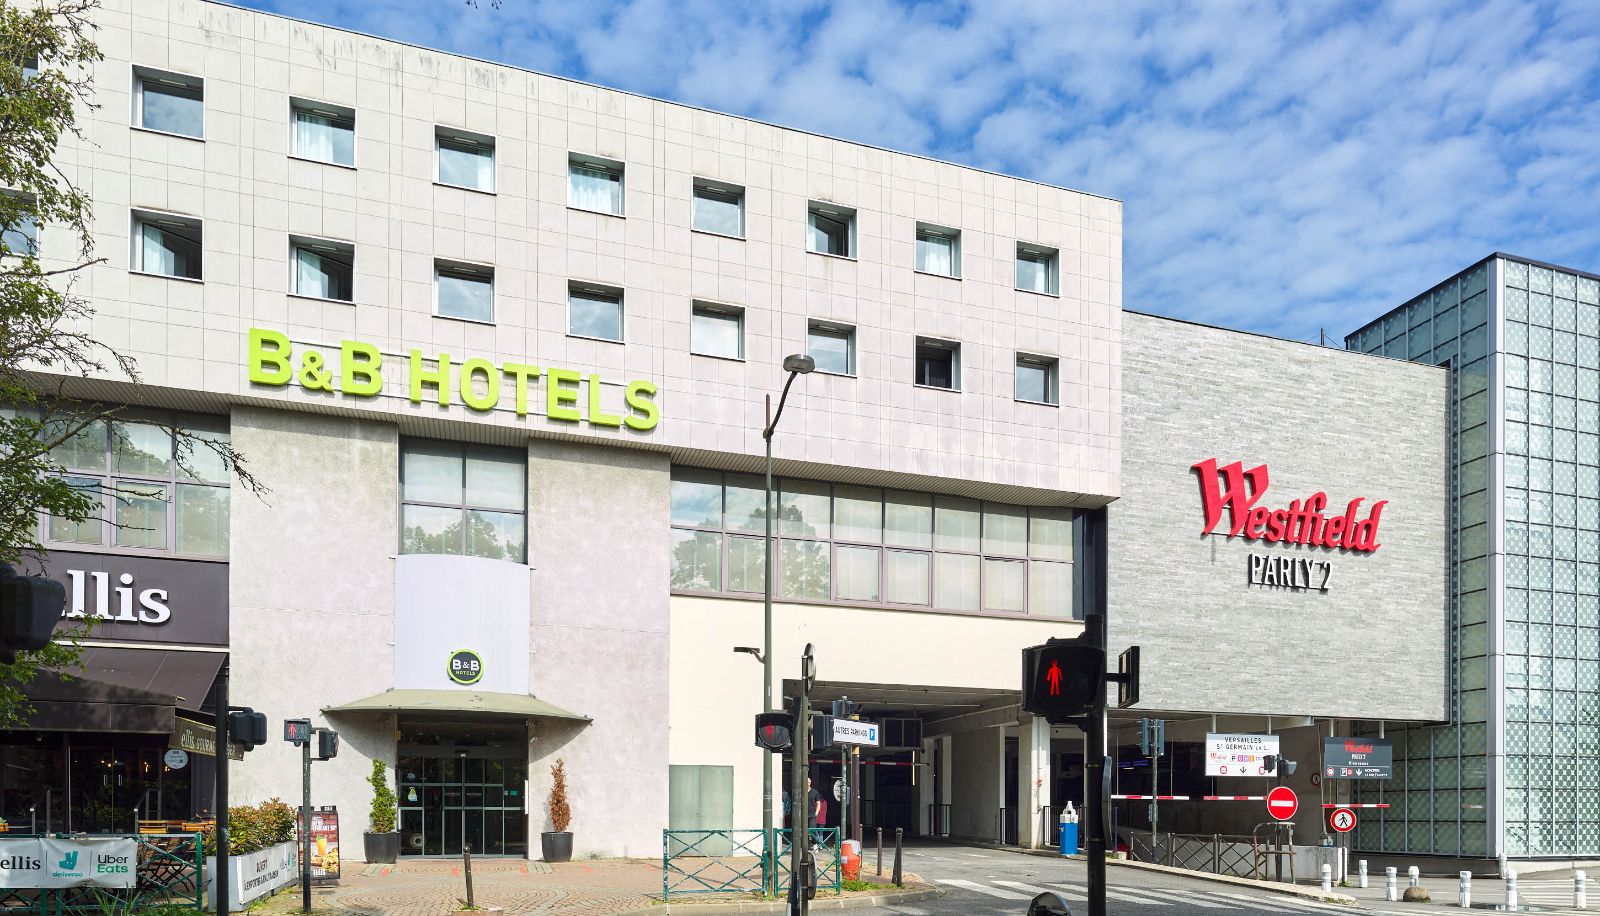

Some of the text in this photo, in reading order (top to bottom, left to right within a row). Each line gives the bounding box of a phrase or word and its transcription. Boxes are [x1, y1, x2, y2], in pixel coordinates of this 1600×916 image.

[248, 326, 661, 432] B&B HOTELS
[1190, 457, 1389, 552] Westfield
[1250, 553, 1334, 590] PARLY 2
[61, 569, 171, 624] llis
[181, 729, 195, 749] ellis
[1224, 736, 1262, 744] VERSAILLES
[1225, 743, 1253, 751] GERMAIN
[0, 856, 41, 870] ellis
[97, 854, 129, 864] Uber
[96, 863, 129, 874] Eats
